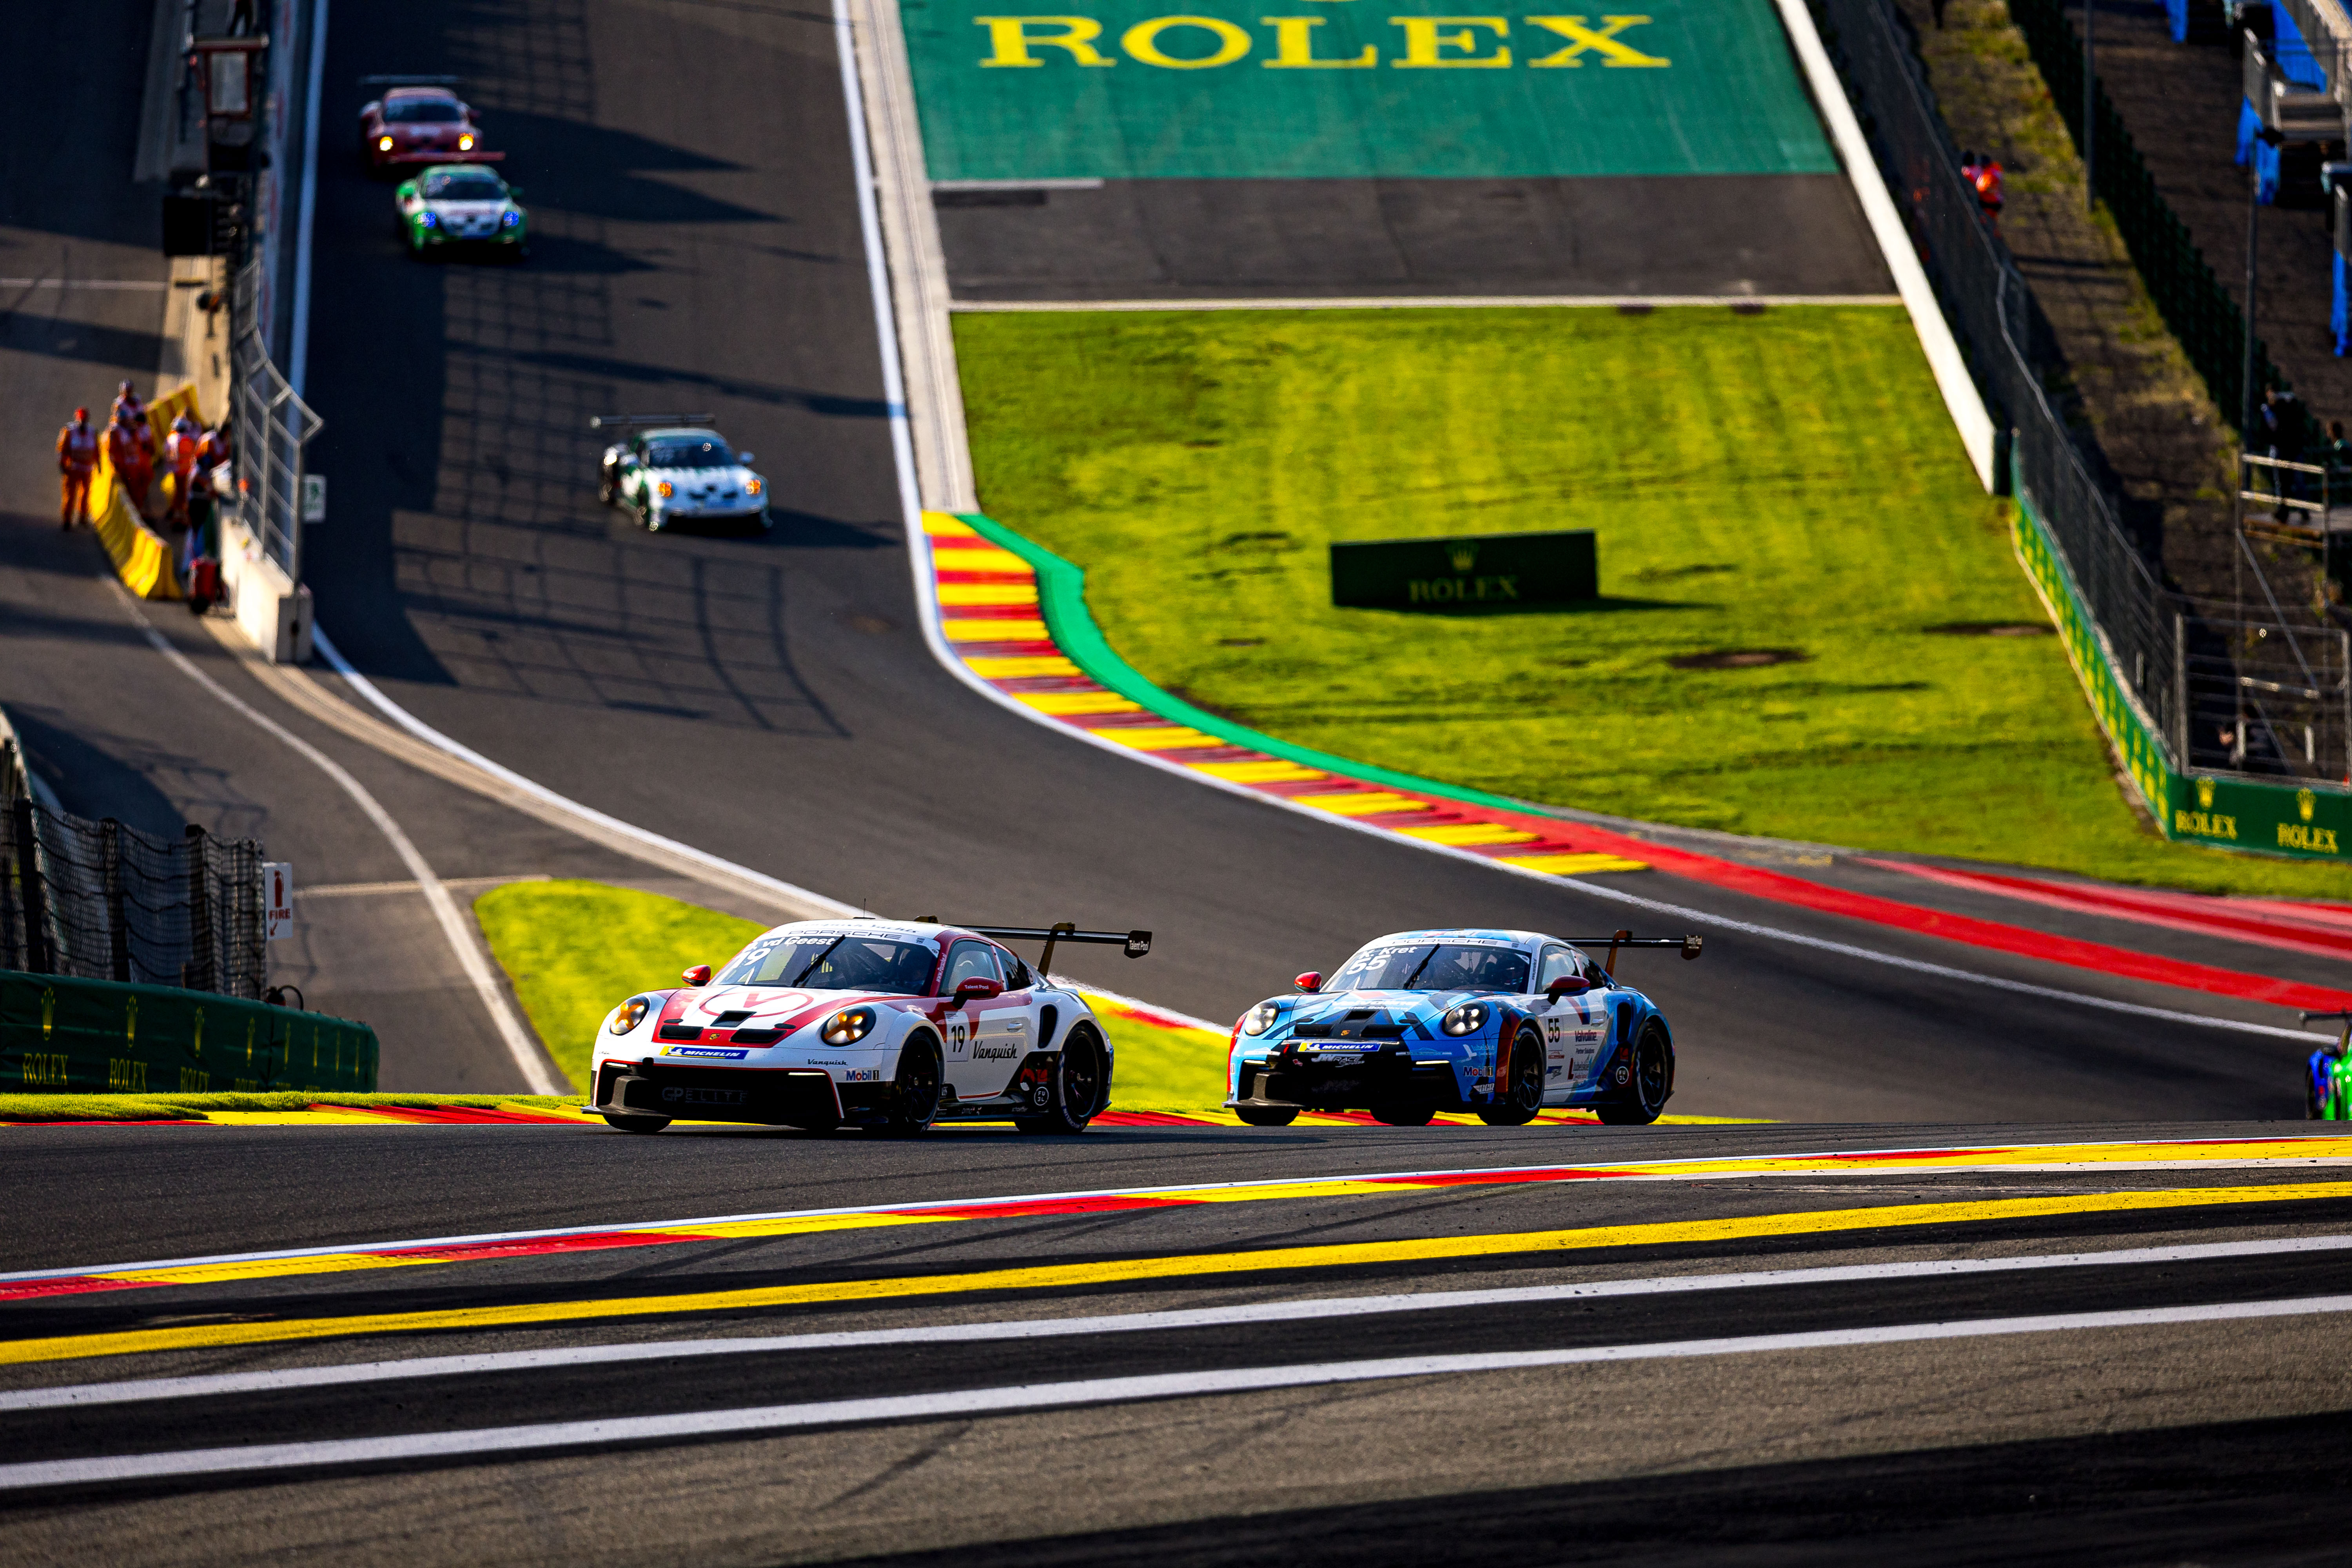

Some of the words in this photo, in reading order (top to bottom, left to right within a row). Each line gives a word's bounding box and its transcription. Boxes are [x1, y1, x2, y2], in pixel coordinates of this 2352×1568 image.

[971, 15, 1672, 70] ROLEX
[1409, 575, 1518, 603] ROLEX
[2175, 809, 2238, 840] ROLEX
[2277, 822, 2339, 854] ROLEX
[269, 907, 290, 920] FIRE
[762, 937, 785, 947] vd
[784, 936, 836, 945] Geest
[788, 930, 902, 940] PORSCHE
[729, 947, 771, 969] 19
[1346, 954, 1391, 975] 55
[1358, 950, 1374, 959] K.
[1379, 947, 1417, 955] Kret
[951, 1025, 965, 1053] 19
[1548, 1018, 1560, 1043] 55
[973, 1040, 1018, 1063] Vanquish
[23, 1053, 68, 1085] ROLEX
[109, 1058, 147, 1093] ROLEX
[846, 1070, 872, 1081] Mobil
[873, 1070, 879, 1081] 1
[1463, 1066, 1487, 1076] Mobil
[1488, 1066, 1493, 1076] 1
